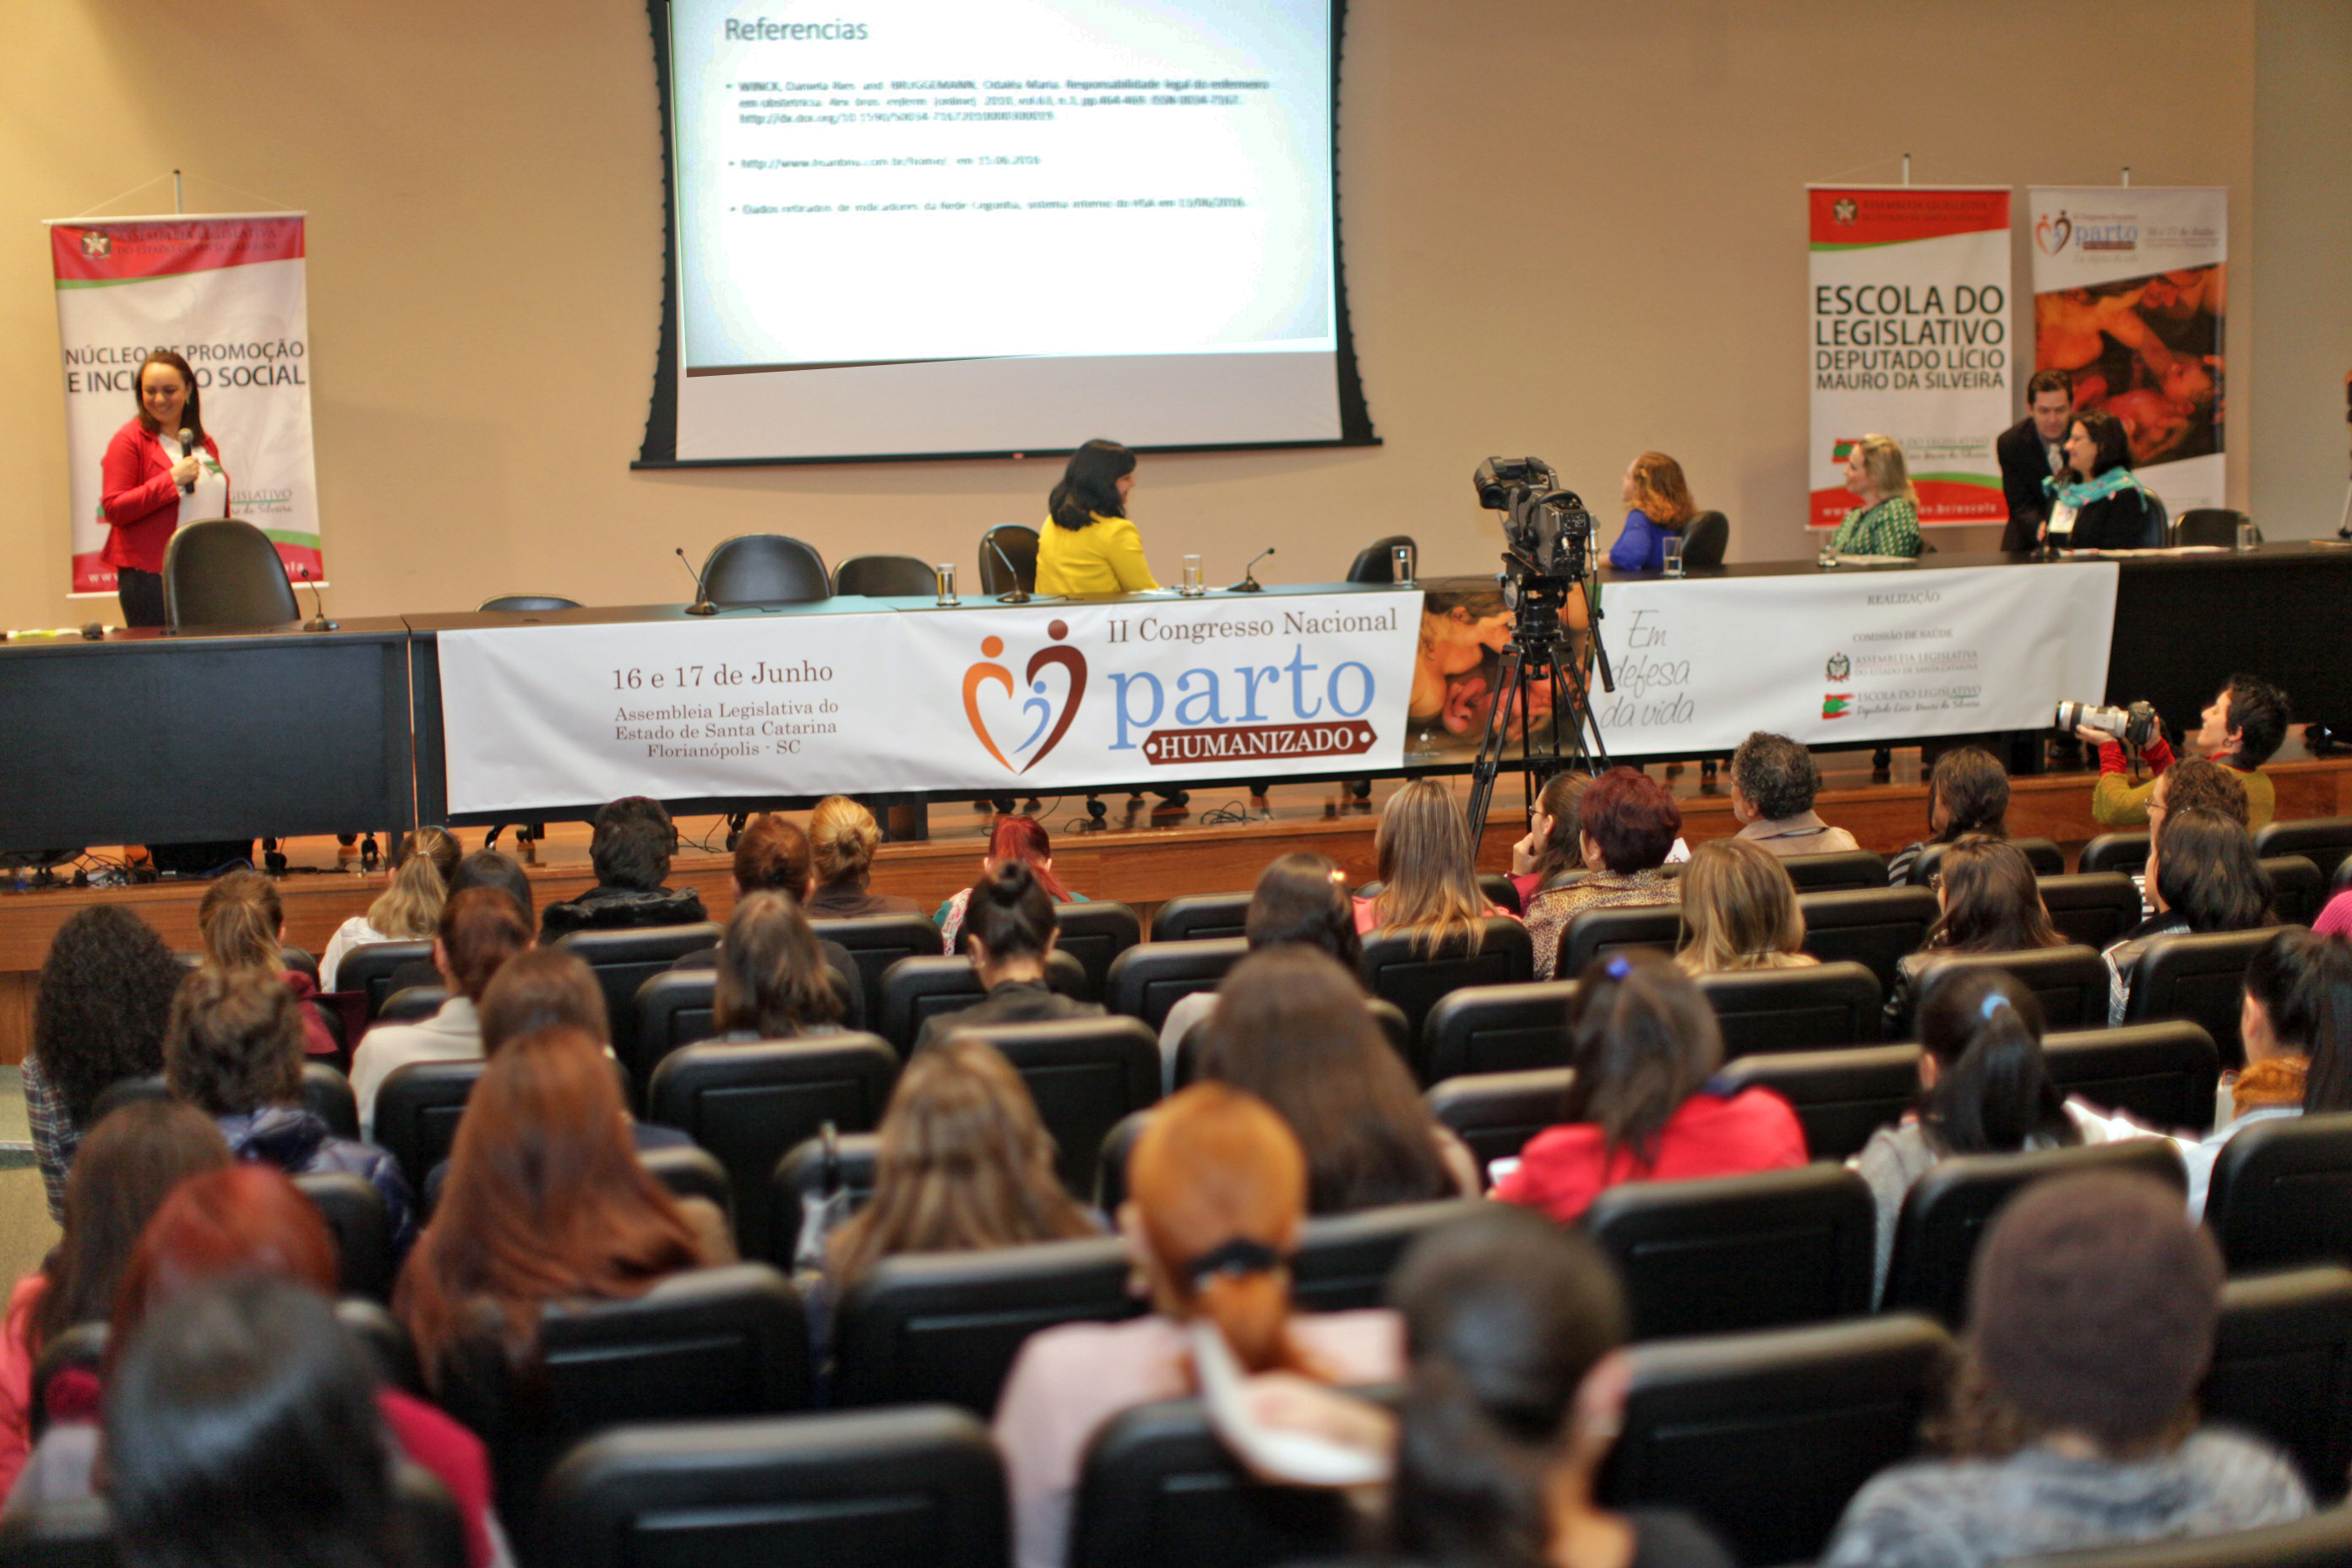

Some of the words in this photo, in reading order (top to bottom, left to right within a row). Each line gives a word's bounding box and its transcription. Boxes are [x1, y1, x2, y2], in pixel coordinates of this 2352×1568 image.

[725, 18, 868, 41] Referencias
[2074, 225, 2139, 246] parto
[1817, 285, 1945, 315] ESCOLA
[1955, 285, 2005, 315] DO
[1816, 318, 2005, 346] LEGISLATIVO
[65, 346, 147, 365] NÚCLEO
[186, 339, 303, 362] PROMOÇÃO
[1816, 349, 1941, 370] DEPUTADO
[1946, 346, 2006, 369] LÍCIO
[68, 373, 81, 393] E
[219, 364, 306, 388] SOCIAL
[1816, 372, 1889, 390] MAURO
[1894, 372, 1920, 390] DA
[1925, 371, 2006, 389] SILVEIRA
[1867, 591, 1941, 606] REALIZAÇÃO
[1108, 618, 1130, 644] II
[1140, 617, 1274, 645] Congresso
[1282, 608, 1398, 635] Nacional
[1628, 610, 1667, 648] Em
[1853, 630, 1902, 643] COMISSÃO
[1904, 630, 1916, 640] DE
[1920, 628, 1953, 639] SAÚDE
[1854, 652, 1915, 665] ASSEMBLEIA
[1919, 649, 1979, 662] LEGISLATIVA
[613, 668, 642, 690] 16
[651, 673, 664, 689] e
[675, 667, 704, 688] 17
[714, 664, 743, 686] de
[752, 660, 833, 685] Junho
[1611, 655, 1690, 699] defesa
[1108, 644, 1375, 750] parto
[1859, 691, 1896, 702] ESCOLA
[1899, 689, 1916, 700] DO
[1919, 684, 1982, 699] LEGISLATIVO
[614, 703, 713, 722] Assembleia
[719, 700, 814, 722] Legislativa
[819, 699, 839, 715] do
[1600, 695, 1635, 728] da
[1642, 692, 1695, 727] vida
[615, 724, 674, 741] Estado
[680, 723, 700, 738] de
[705, 721, 755, 738] Santa
[762, 720, 837, 736] Catarina
[647, 742, 760, 760] Florianópolis
[776, 740, 802, 756] SC
[1160, 727, 1353, 760] HUMANIZADO
